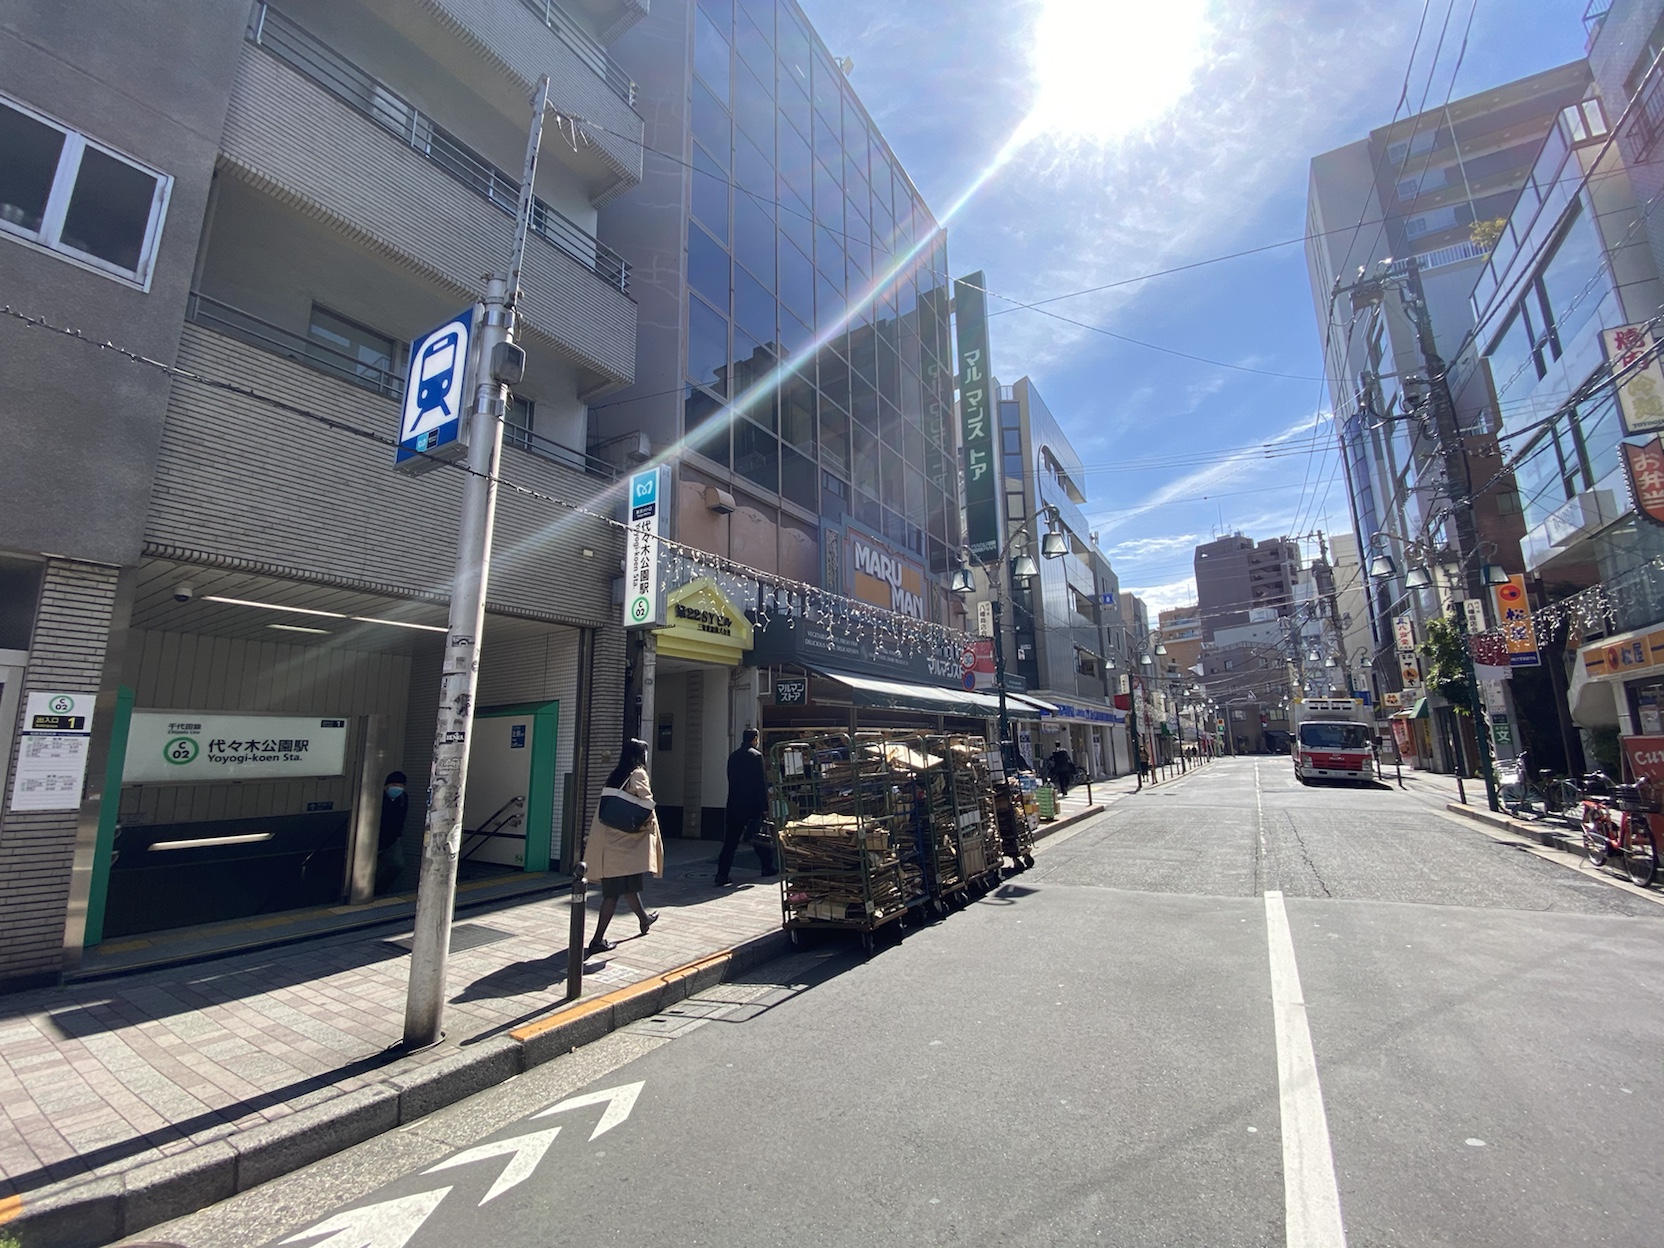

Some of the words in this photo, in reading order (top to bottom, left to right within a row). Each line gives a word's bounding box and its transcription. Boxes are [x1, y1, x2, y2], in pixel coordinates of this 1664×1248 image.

[964, 348, 988, 482] マルマンストア
[640, 520, 652, 595] 代々木公園駅
[855, 541, 903, 588] MARU
[891, 587, 924, 620] MAN
[635, 608, 645, 617] 02
[777, 683, 804, 693] マルマン
[780, 692, 801, 702] ストア
[67, 717, 76, 729] 1
[179, 742, 187, 750] C
[208, 739, 309, 753] 代々木公園駅
[172, 750, 190, 759] 02
[207, 753, 280, 765] Yoyogi-koen
[283, 753, 303, 762] Sta.
